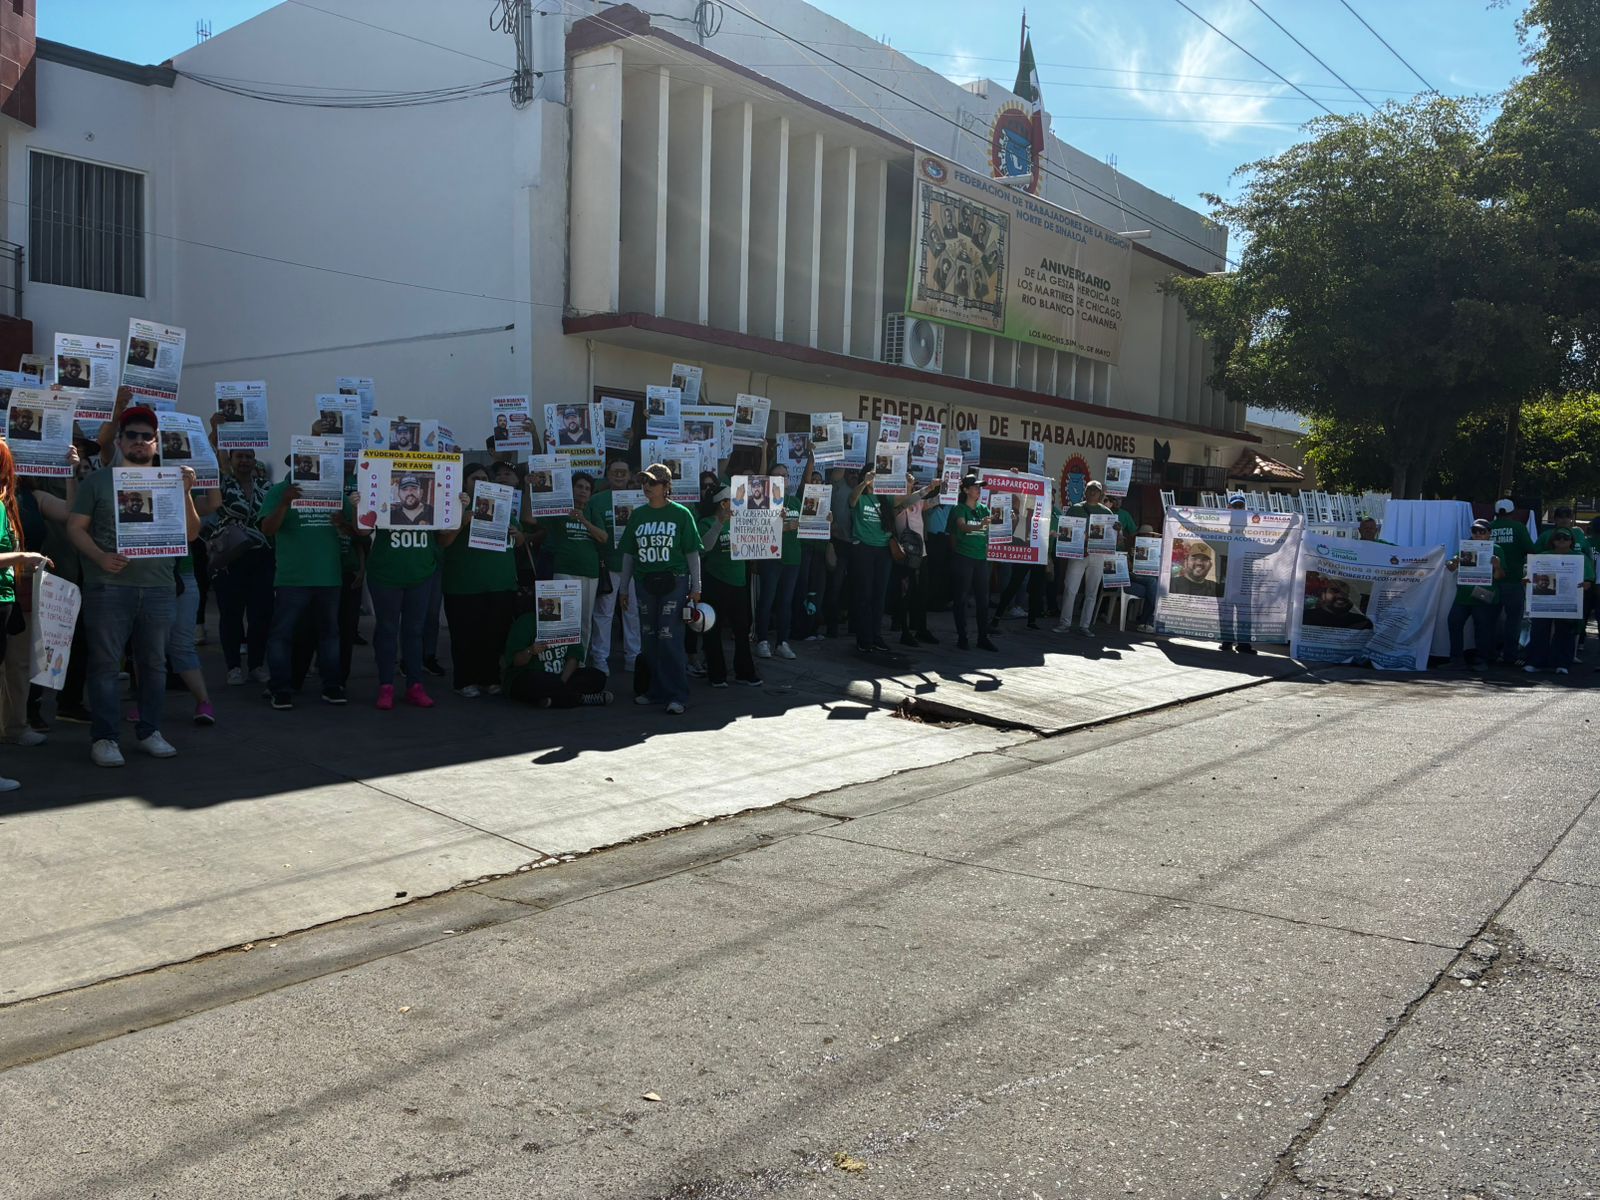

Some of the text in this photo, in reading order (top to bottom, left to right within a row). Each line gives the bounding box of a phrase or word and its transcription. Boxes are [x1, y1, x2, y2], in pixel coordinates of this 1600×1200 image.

[954, 172, 1011, 202] FEDERACION
[1012, 194, 1023, 206] DE
[1025, 200, 1082, 231] TRABAJADORES
[1083, 225, 1092, 234] DE
[1016, 211, 1087, 245] NORTE DE SINALOA
[1040, 258, 1111, 292] ANIVERSARIO
[1017, 278, 1033, 291] LOS
[1034, 284, 1074, 304] MARTIRES
[1024, 266, 1120, 308] DE LA GESTA HEROICA DE
[1021, 293, 1117, 331] RIO BLANCO CANANEA
[1029, 329, 1041, 339] LOS
[858, 395, 1136, 454] FEDERACION DE TRABAJADORES
[370, 474, 378, 506] OMAR
[987, 478, 1039, 490] DESAPARECIDO
[1032, 502, 1042, 540] URGENTE
[1193, 513, 1220, 521] Sinaloa
[635, 521, 677, 536] OMAR
[733, 526, 775, 534] INTERVENGA A
[1490, 528, 1513, 536] USTICIA
[390, 531, 428, 548] SOLO
[737, 534, 769, 544] ENCONTRAR
[771, 535, 776, 543] A
[1200, 533, 1232, 541] ROBERTO
[638, 547, 670, 563] SOLO
[741, 543, 767, 557] OMAR
[987, 551, 1007, 559] COSTA
[1004, 545, 1032, 553] ROBERTO
[1331, 551, 1358, 561] Sinaloa
[1317, 566, 1338, 575] OMAR
[1338, 570, 1371, 580] ROBERTO
[538, 646, 569, 662] NO EST
[544, 660, 561, 675] SO
